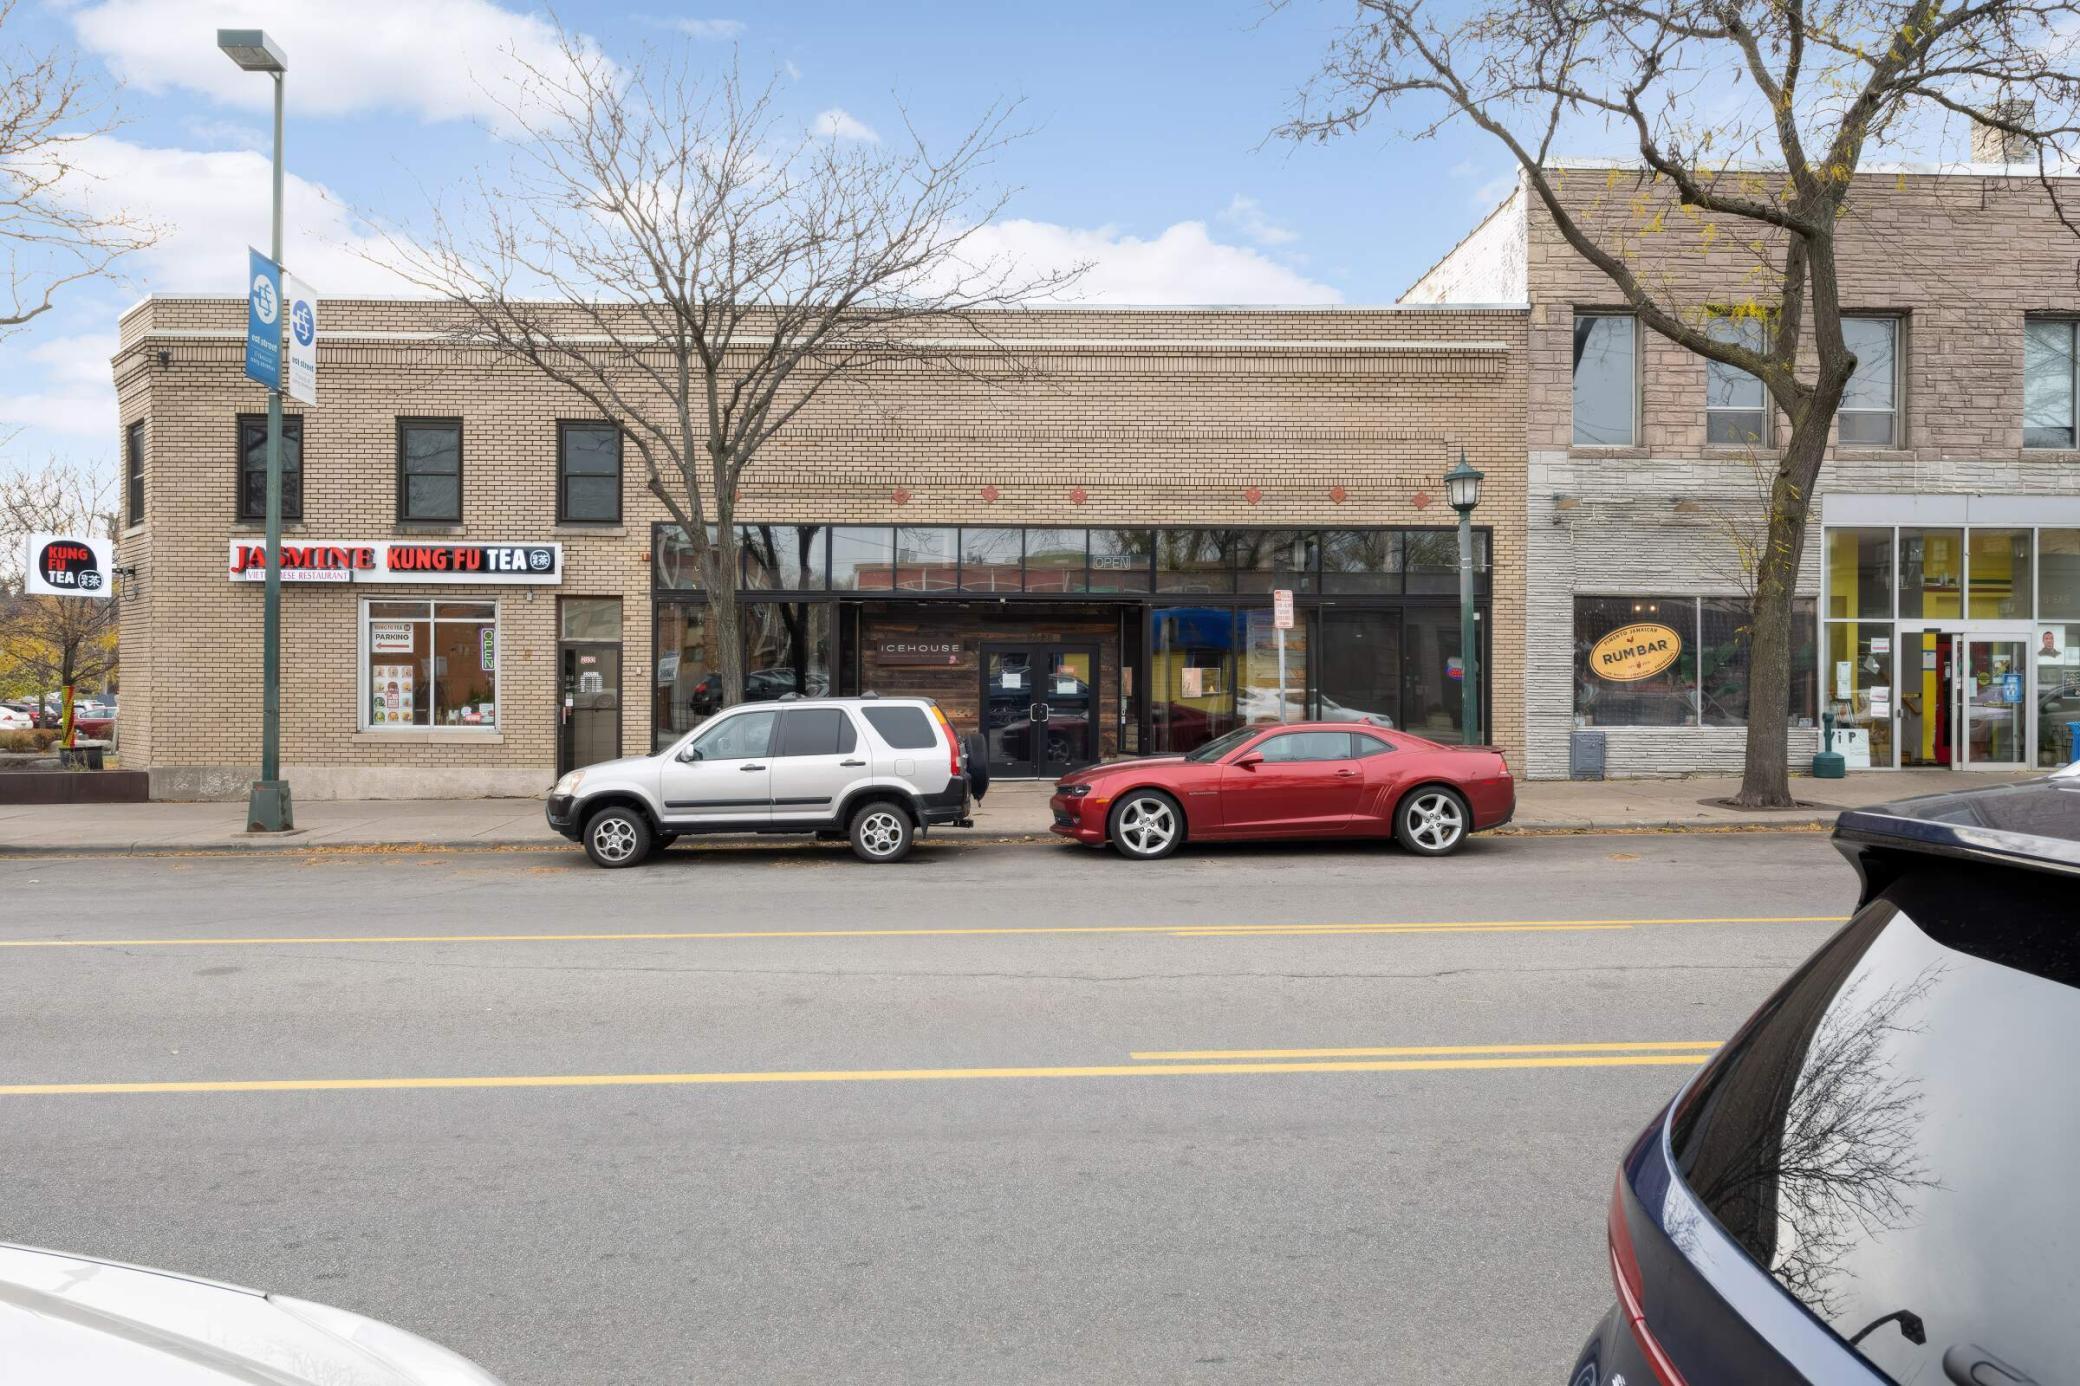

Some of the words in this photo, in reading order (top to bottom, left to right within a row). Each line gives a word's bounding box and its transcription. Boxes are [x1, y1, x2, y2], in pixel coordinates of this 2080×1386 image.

[48, 546, 88, 560] KUNG
[387, 547, 448, 570] KUNG
[453, 548, 481, 570] FU
[487, 549, 527, 571] TEA
[48, 559, 66, 571] FU
[231, 546, 376, 573] JASMINE
[1095, 557, 1129, 569] OPEN
[48, 571, 75, 584] TEA
[247, 571, 297, 580] VIETESE
[298, 571, 348, 580] RESTAURANT
[375, 633, 409, 641] PARKING
[483, 630, 494, 669] OPEN
[880, 644, 960, 652] ICEHOUSE
